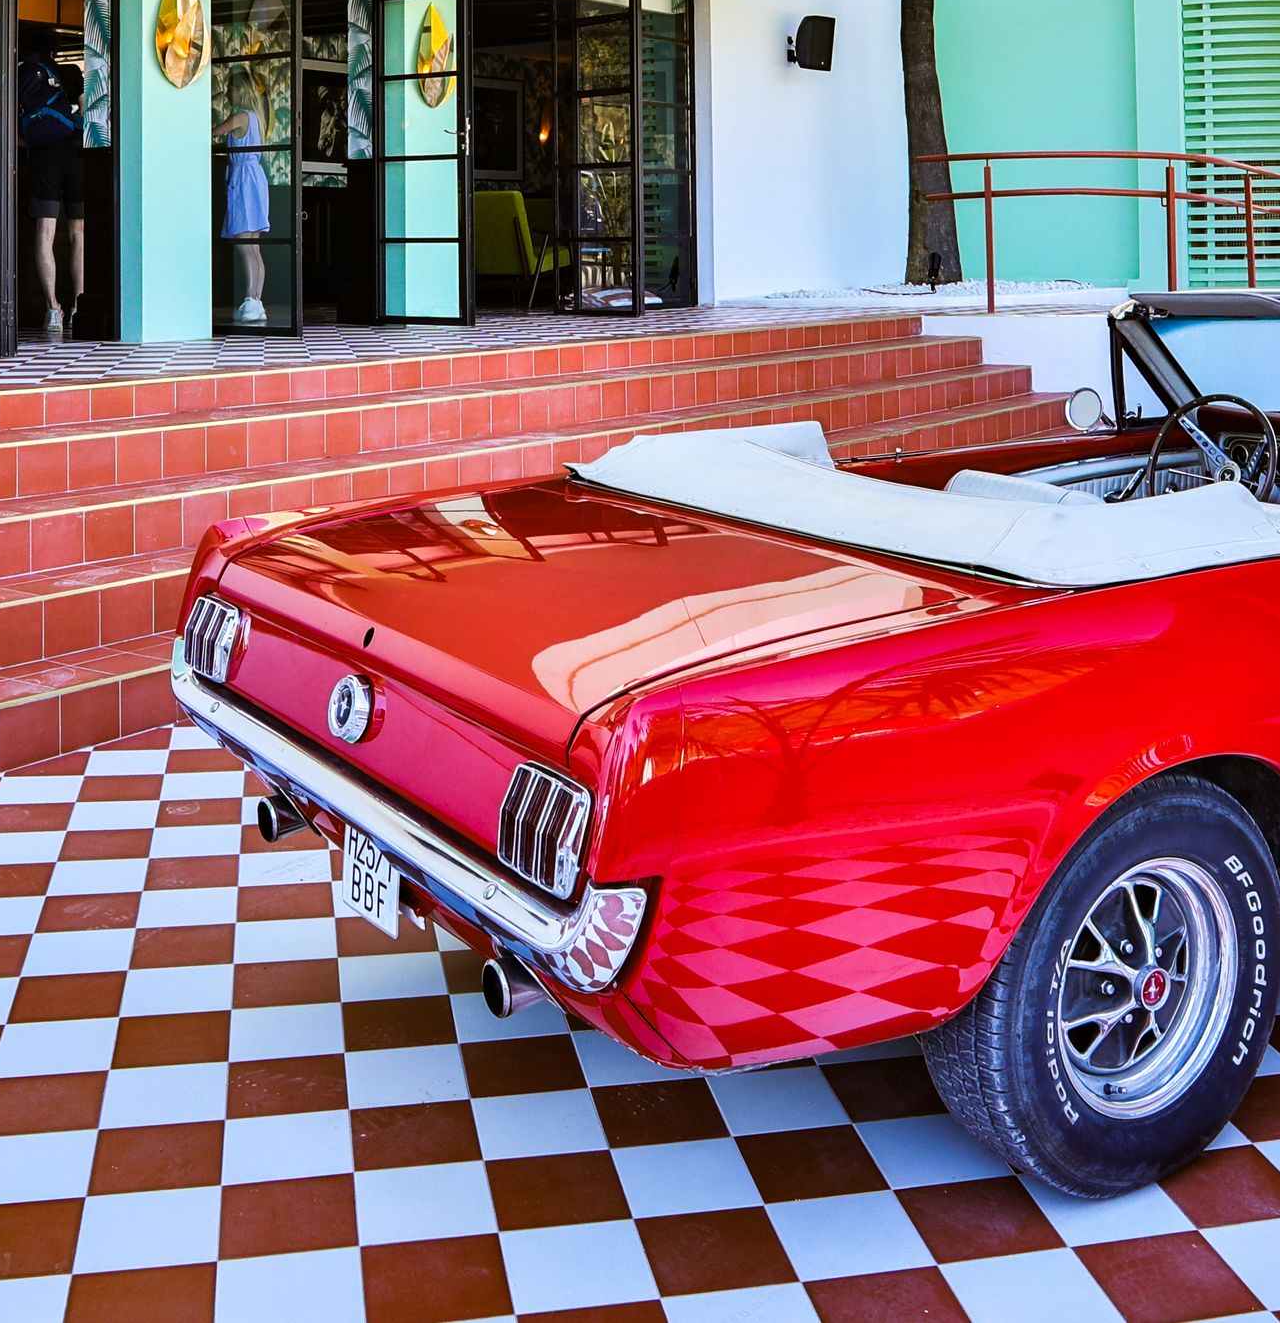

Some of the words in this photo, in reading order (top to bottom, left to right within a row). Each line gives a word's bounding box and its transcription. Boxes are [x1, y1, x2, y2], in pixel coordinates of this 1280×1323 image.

[351, 863, 387, 919] BBF
[1224, 854, 1267, 1066] BFGoodrich
[1045, 1010, 1080, 1126] Radial
